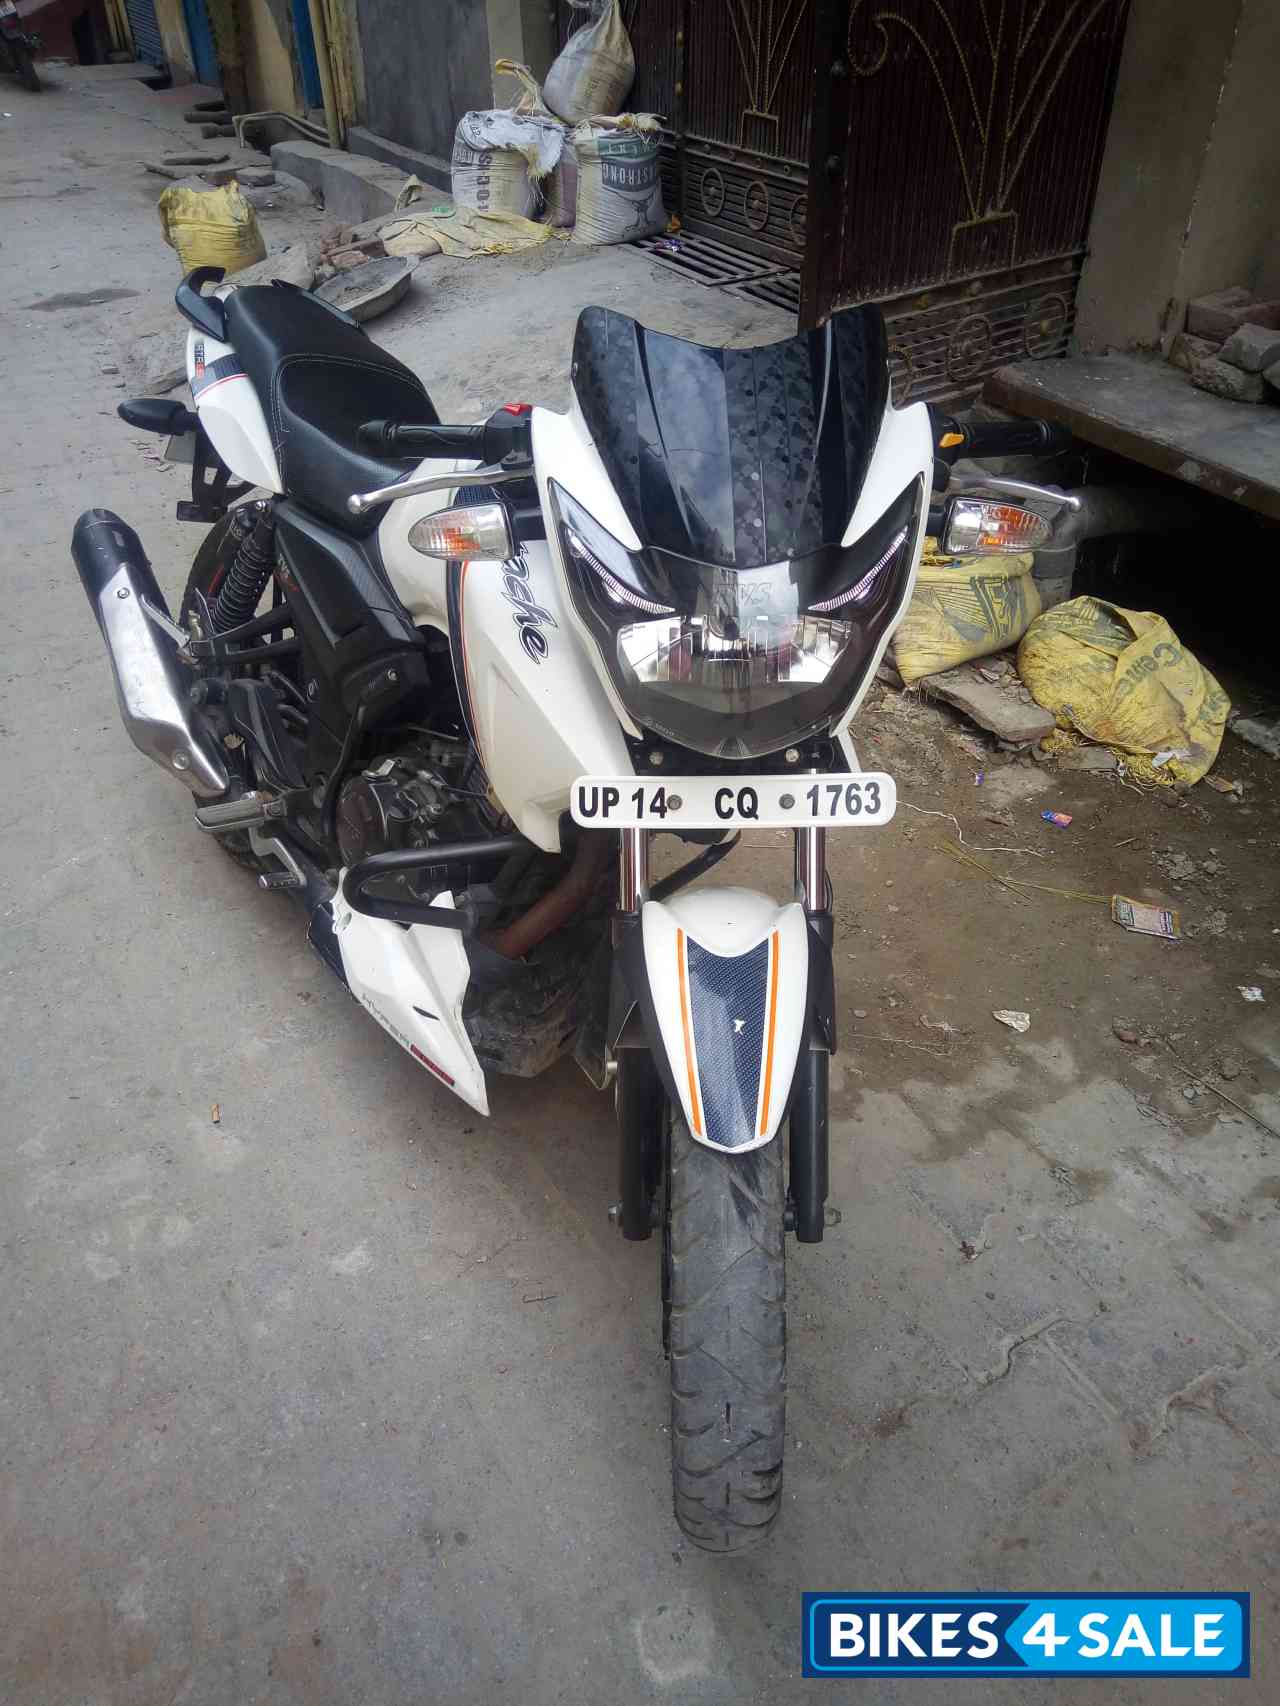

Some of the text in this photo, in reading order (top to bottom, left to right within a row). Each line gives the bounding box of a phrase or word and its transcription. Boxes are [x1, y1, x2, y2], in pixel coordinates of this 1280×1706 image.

[578, 781, 881, 820] UP 14 CQ 1763
